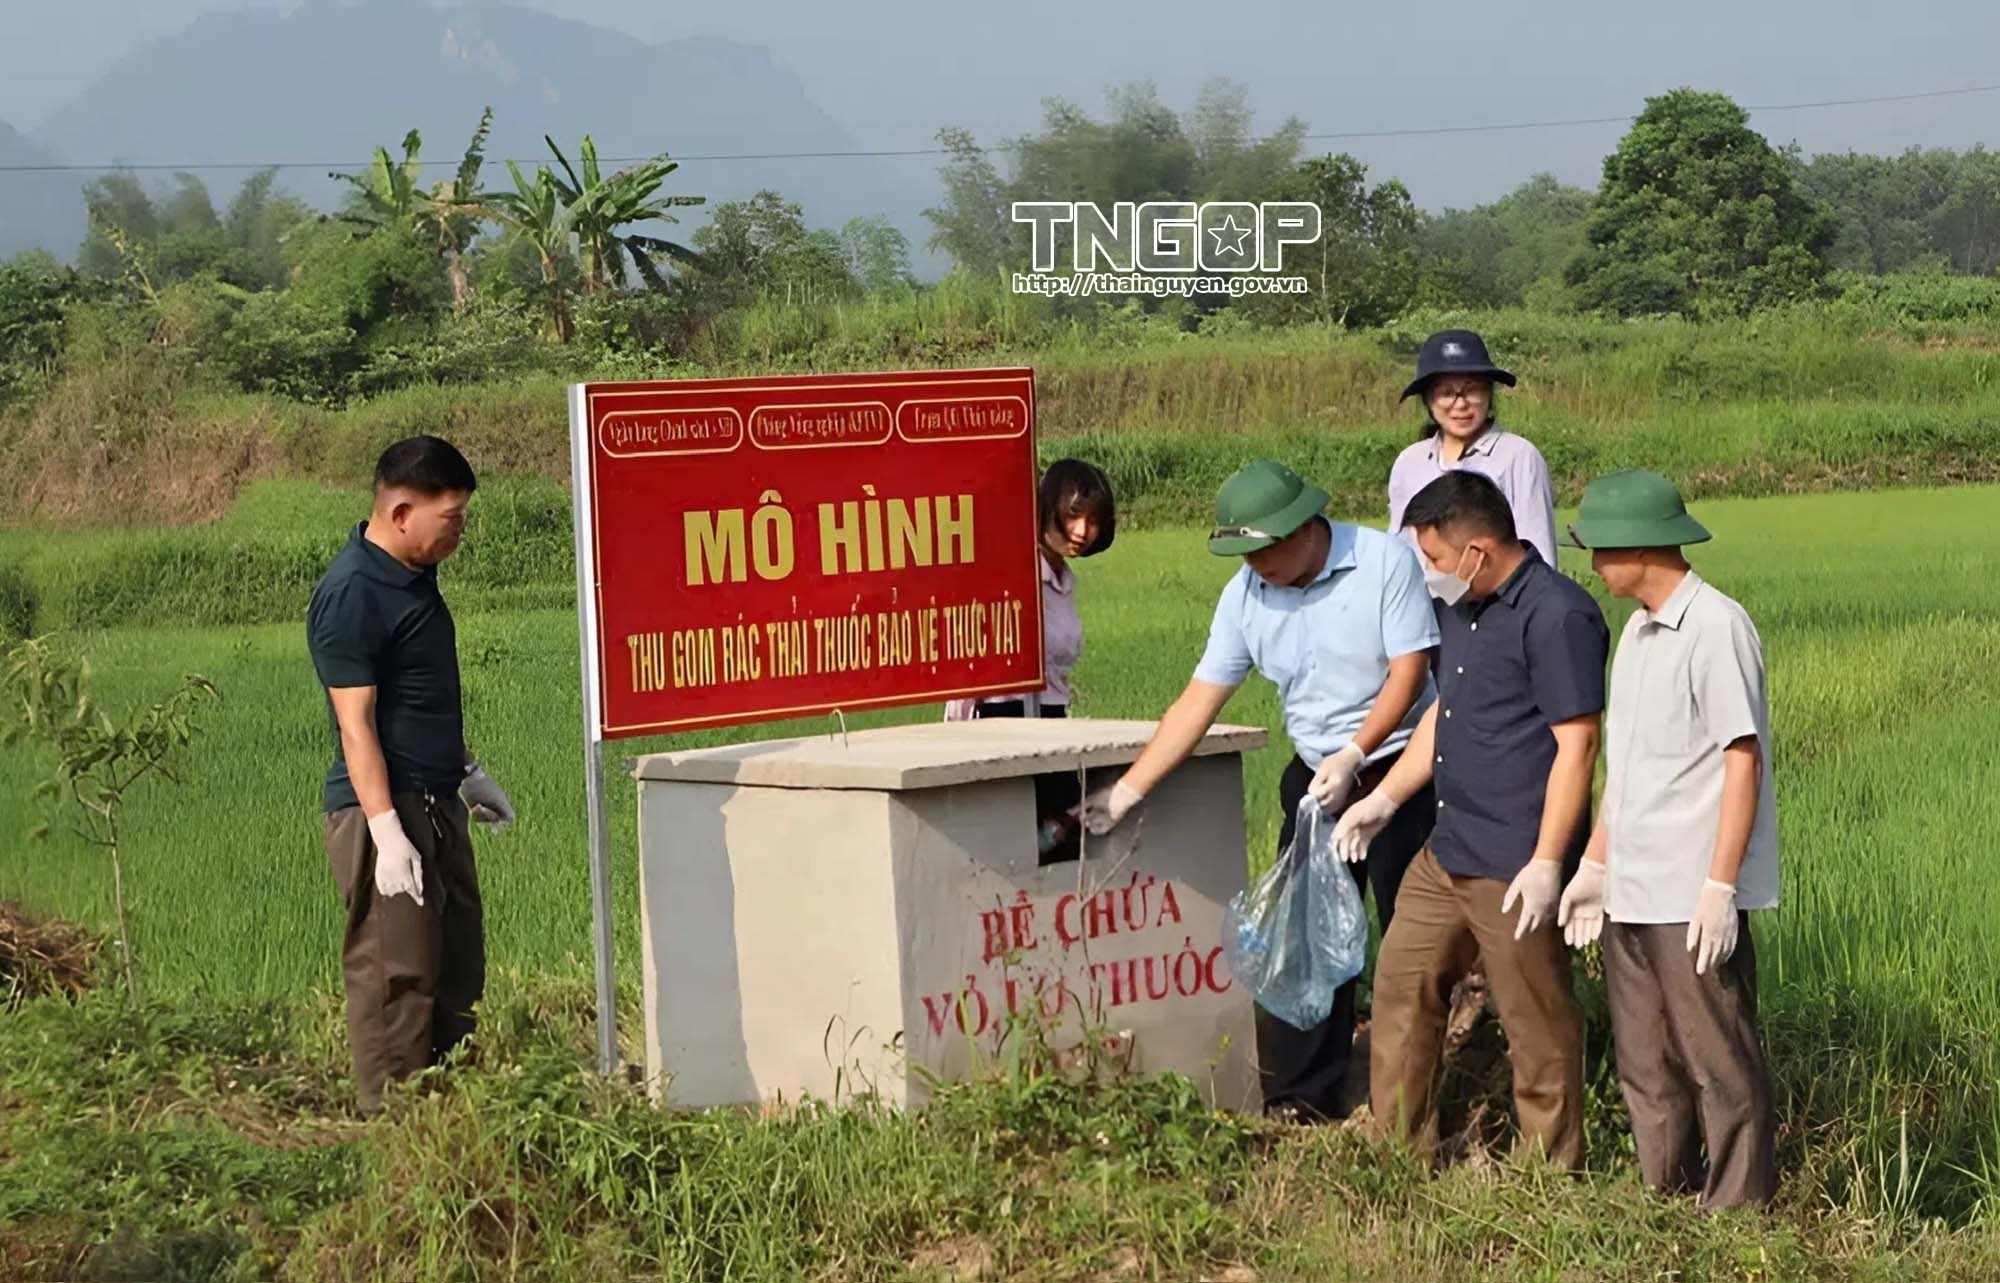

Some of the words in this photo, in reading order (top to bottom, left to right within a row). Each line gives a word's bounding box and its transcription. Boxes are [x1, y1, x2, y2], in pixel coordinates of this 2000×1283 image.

[683, 489, 795, 586] MÔ
[818, 484, 975, 576] HÌNH
[627, 631, 666, 693] THU
[672, 627, 716, 689] GOM
[722, 612, 761, 684] RÁC
[766, 595, 809, 679] THẢI
[814, 593, 871, 674] THUỐC
[877, 586, 912, 667] BẢO
[918, 595, 939, 675] VỆ
[943, 597, 987, 671] THỰC
[991, 589, 1023, 667] VẬT
[1055, 871, 1182, 946] CHỨA
